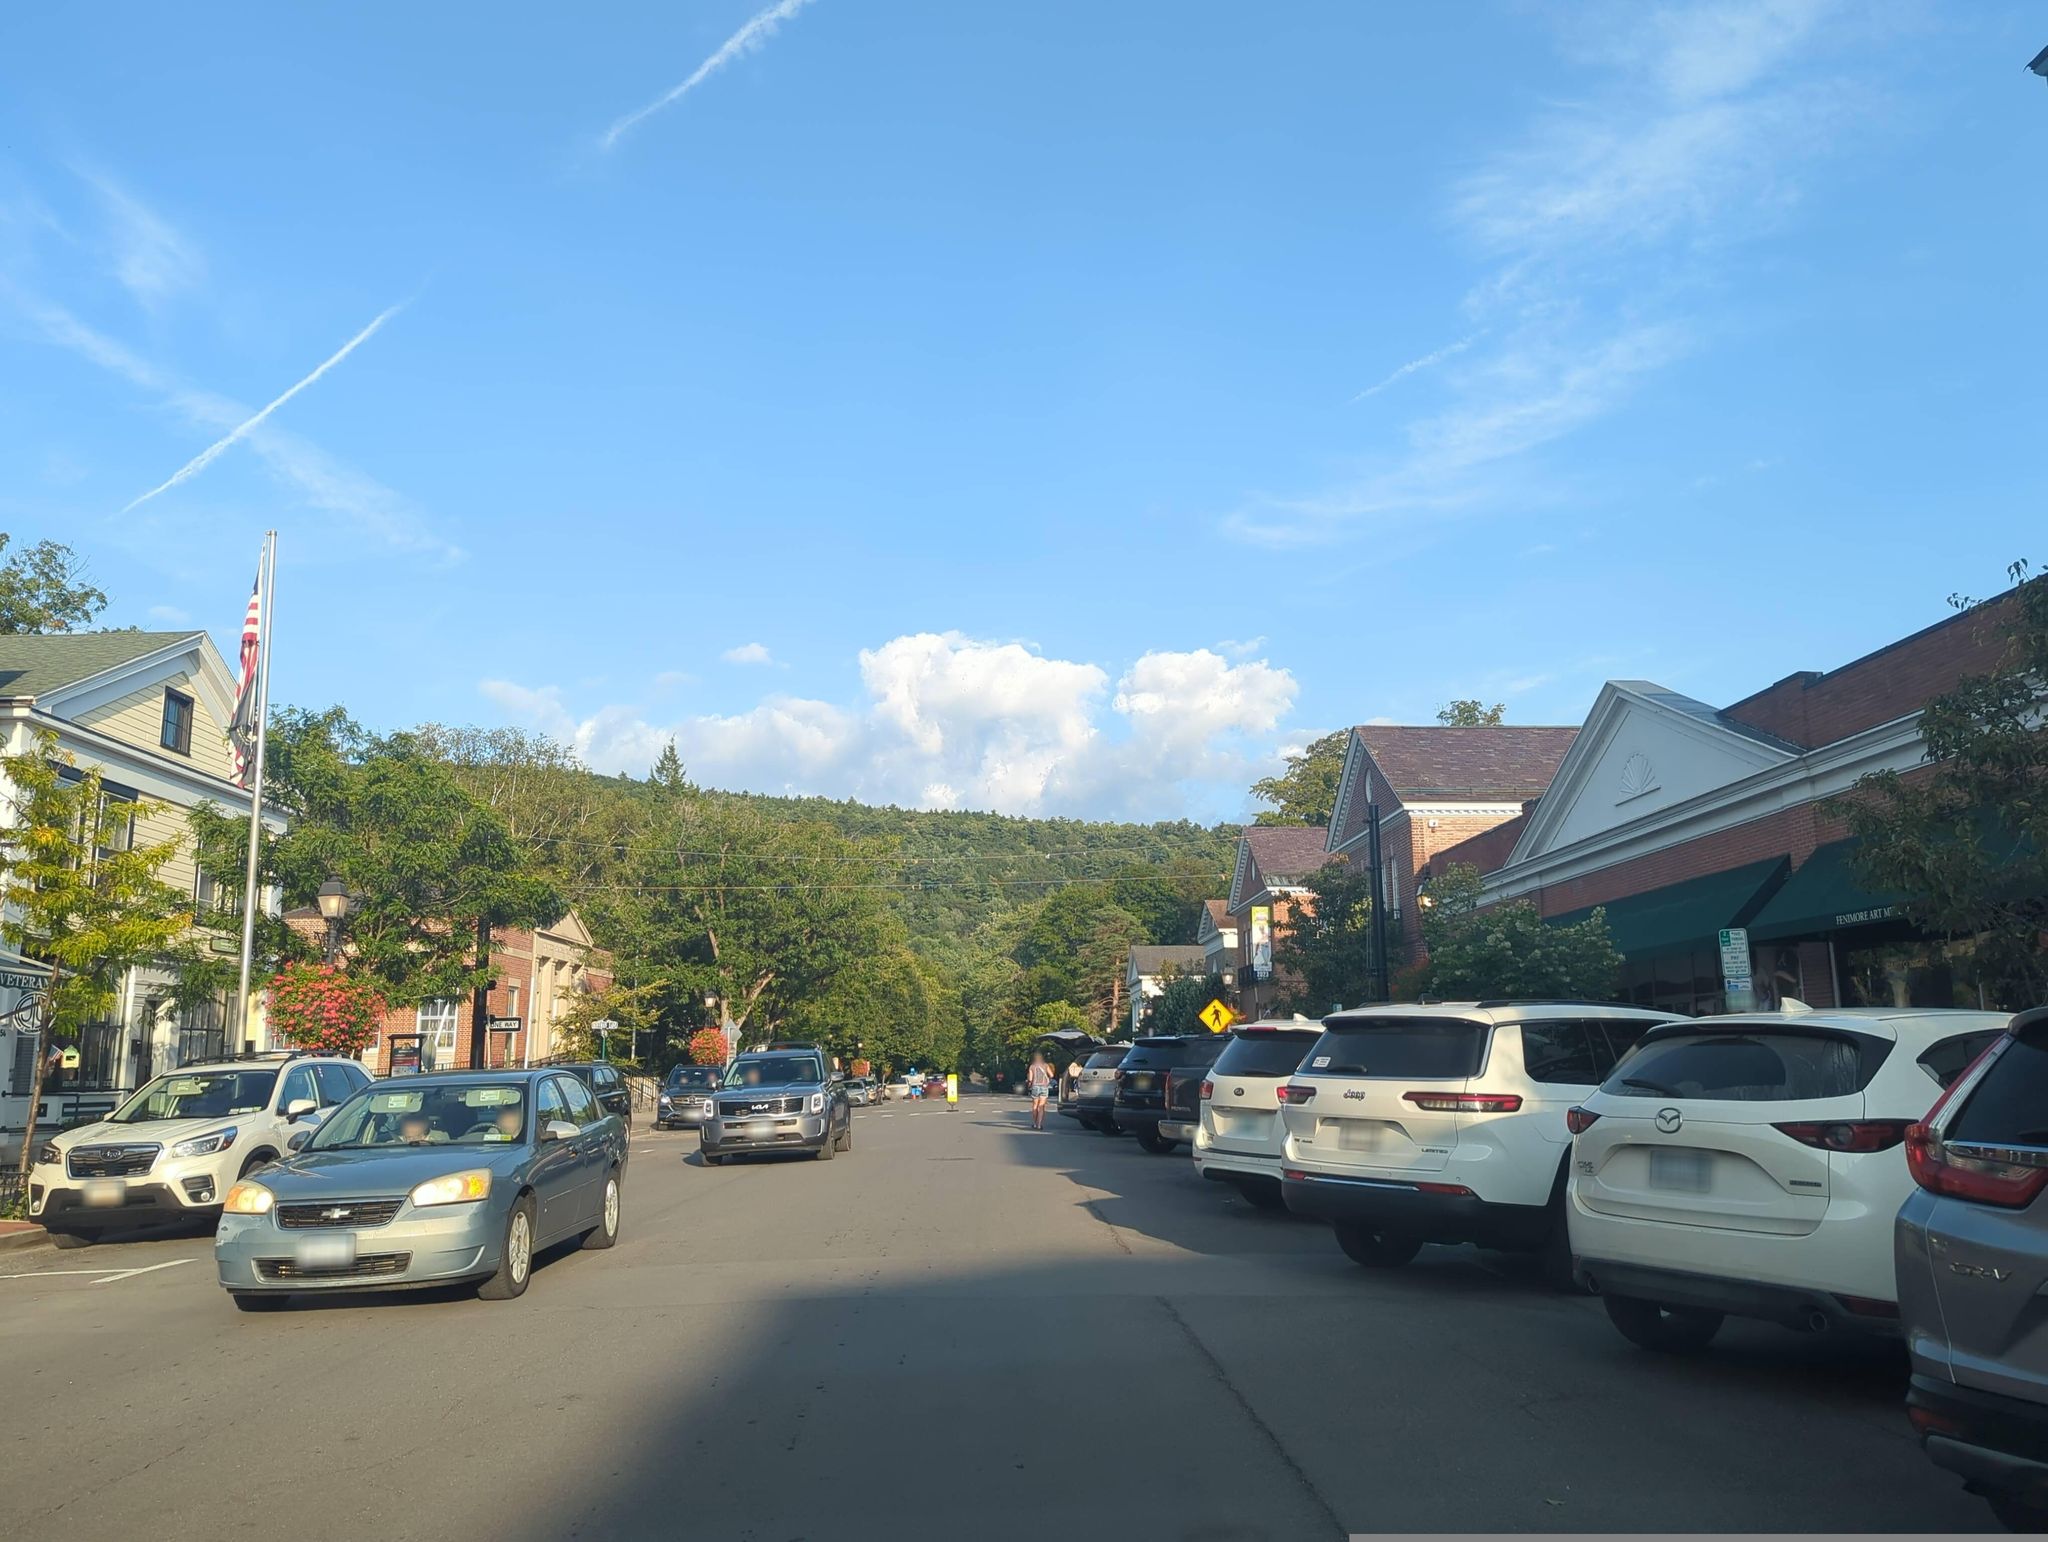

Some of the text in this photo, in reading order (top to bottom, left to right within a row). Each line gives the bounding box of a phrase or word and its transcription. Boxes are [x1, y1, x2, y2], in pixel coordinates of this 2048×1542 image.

[1836, 911, 1869, 925] FENIMORE
[1869, 908, 1883, 920] ART
[1343, 1089, 1366, 1101] Jeep
